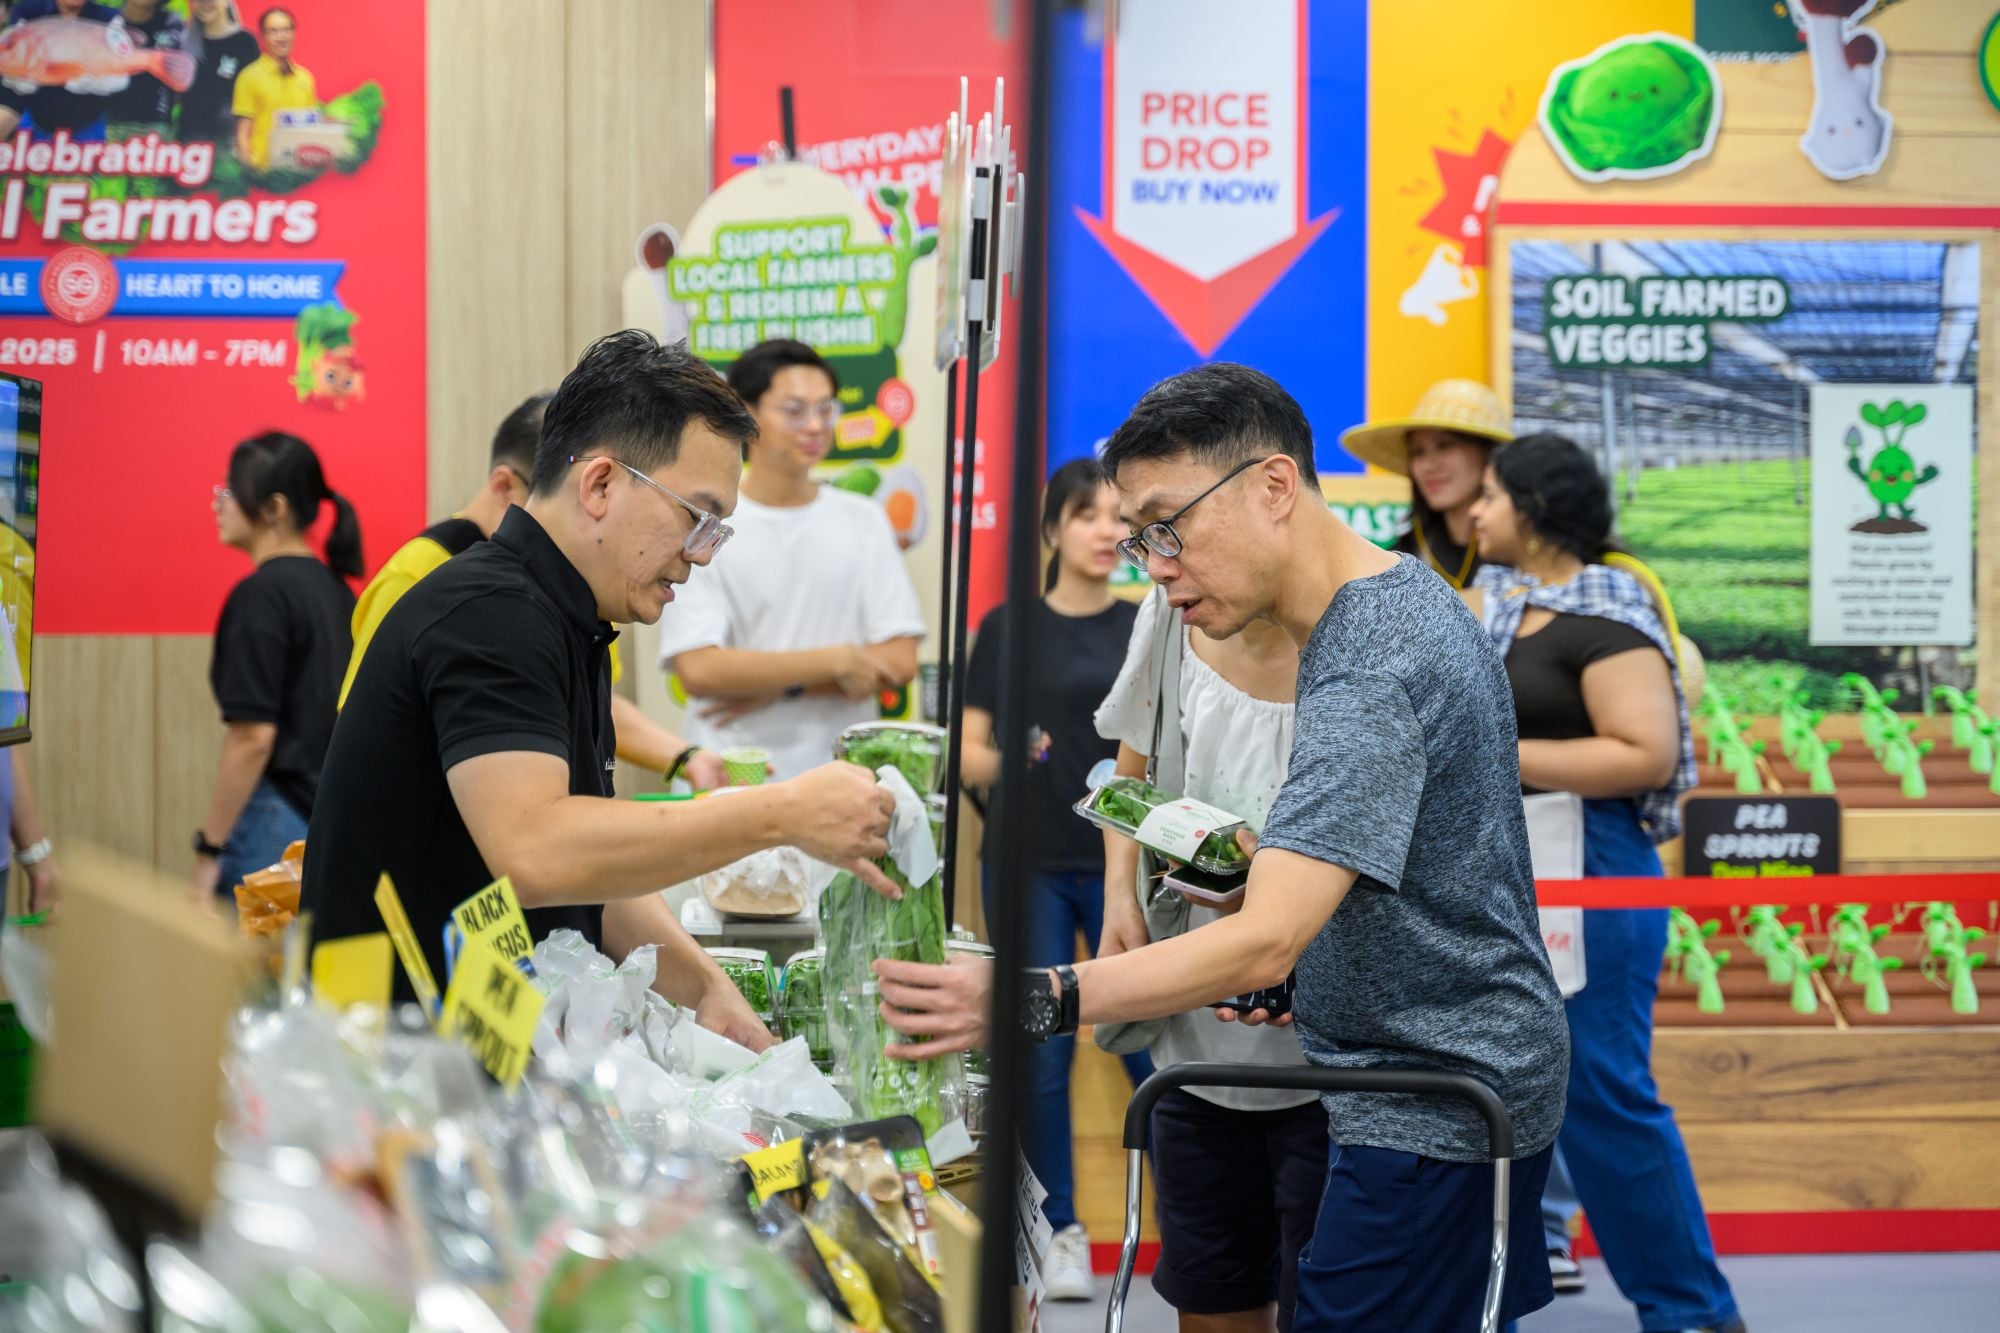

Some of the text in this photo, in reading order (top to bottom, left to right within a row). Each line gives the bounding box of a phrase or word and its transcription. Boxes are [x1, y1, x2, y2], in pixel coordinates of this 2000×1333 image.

[1142, 91, 1269, 128] PRICE
[1142, 136, 1271, 172] DROP
[1131, 178, 1279, 204] BUY NOW
[42, 182, 319, 243] Farmers
[718, 222, 845, 259] SUPPORT
[125, 272, 322, 300] HEART TO HOME
[674, 252, 894, 293] LOCAL FARMERS
[729, 287, 829, 320] REDEEM
[1550, 278, 1787, 319] SOIL FARMED
[0, 338, 77, 366] 2025
[120, 338, 197, 367] 10AM
[224, 339, 287, 368] 7PM
[1550, 323, 1708, 364] VEGGIES
[1734, 803, 1788, 830] PEA
[1703, 832, 1821, 859] SPROUTS
[461, 886, 511, 934] BLACK
